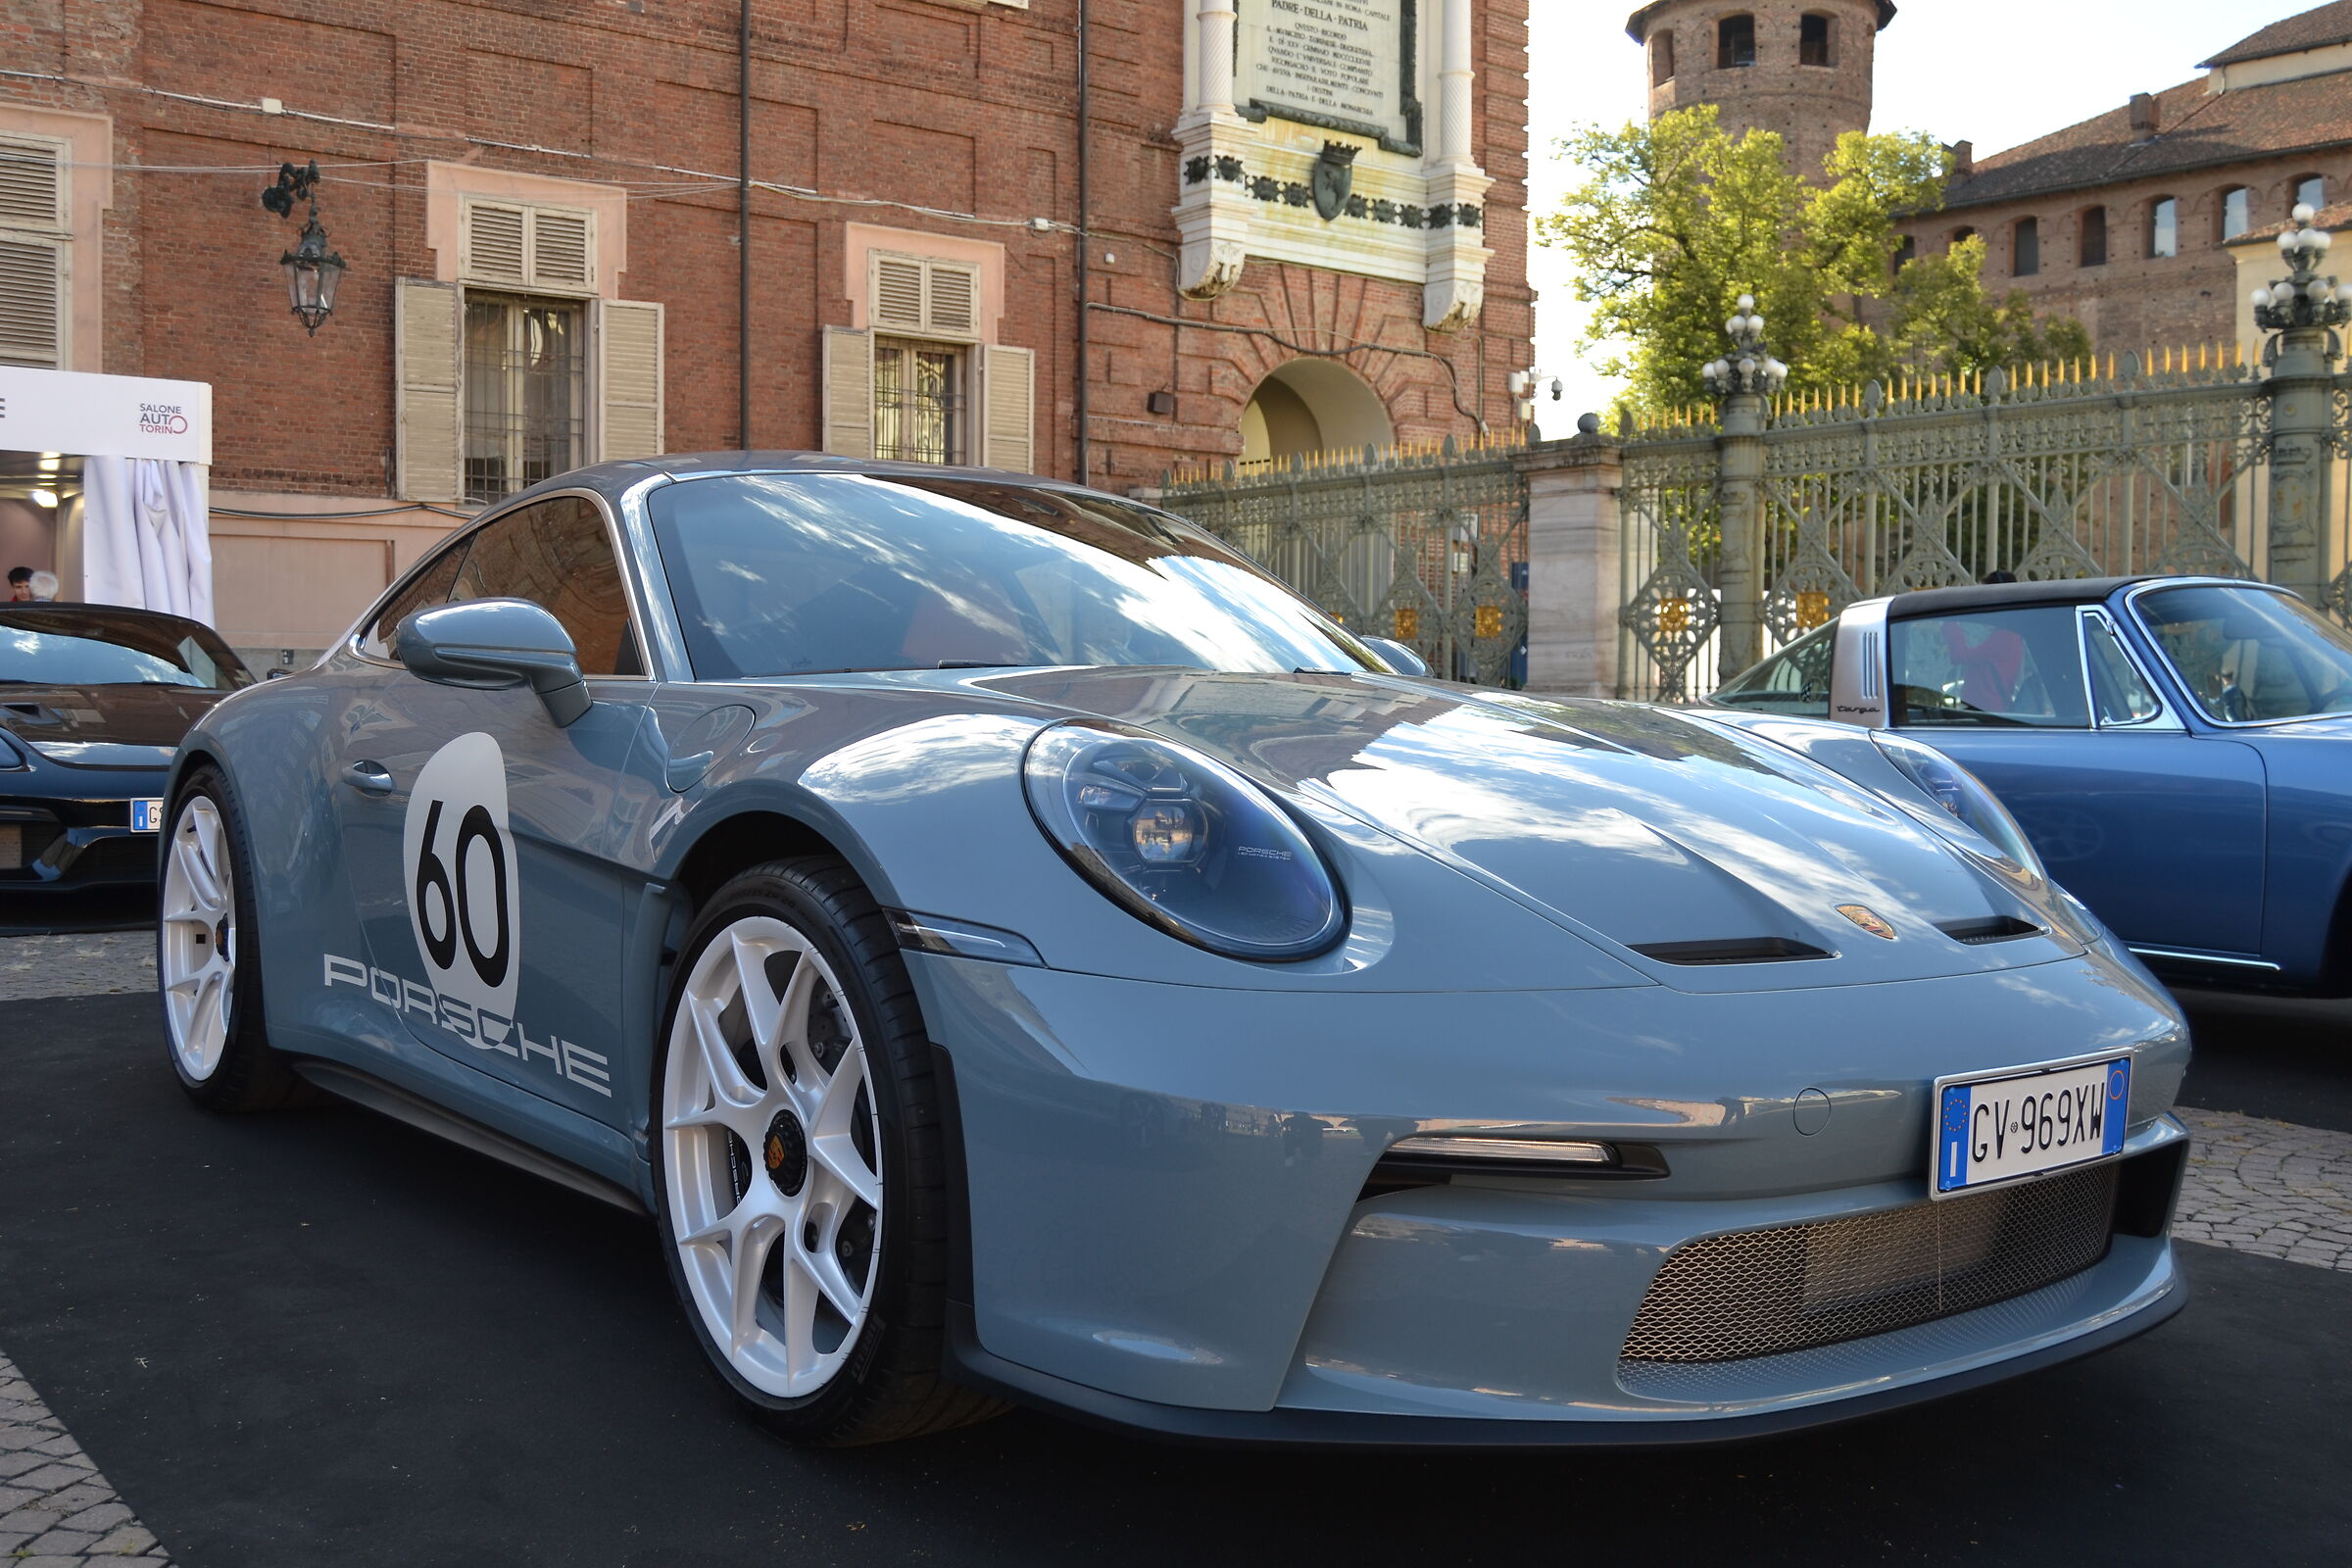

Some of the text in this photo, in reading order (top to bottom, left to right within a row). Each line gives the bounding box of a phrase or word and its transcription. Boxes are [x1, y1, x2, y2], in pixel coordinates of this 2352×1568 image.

[1272, 0, 1368, 30] PADRE DELLA PATRIA
[139, 403, 182, 415] SALONE
[1238, 846, 1292, 858] PORSCHE
[416, 800, 510, 988] 60
[324, 954, 612, 1098] PORSCHE
[1972, 1100, 2010, 1162] GV
[2020, 1082, 2105, 1153] 969XW
